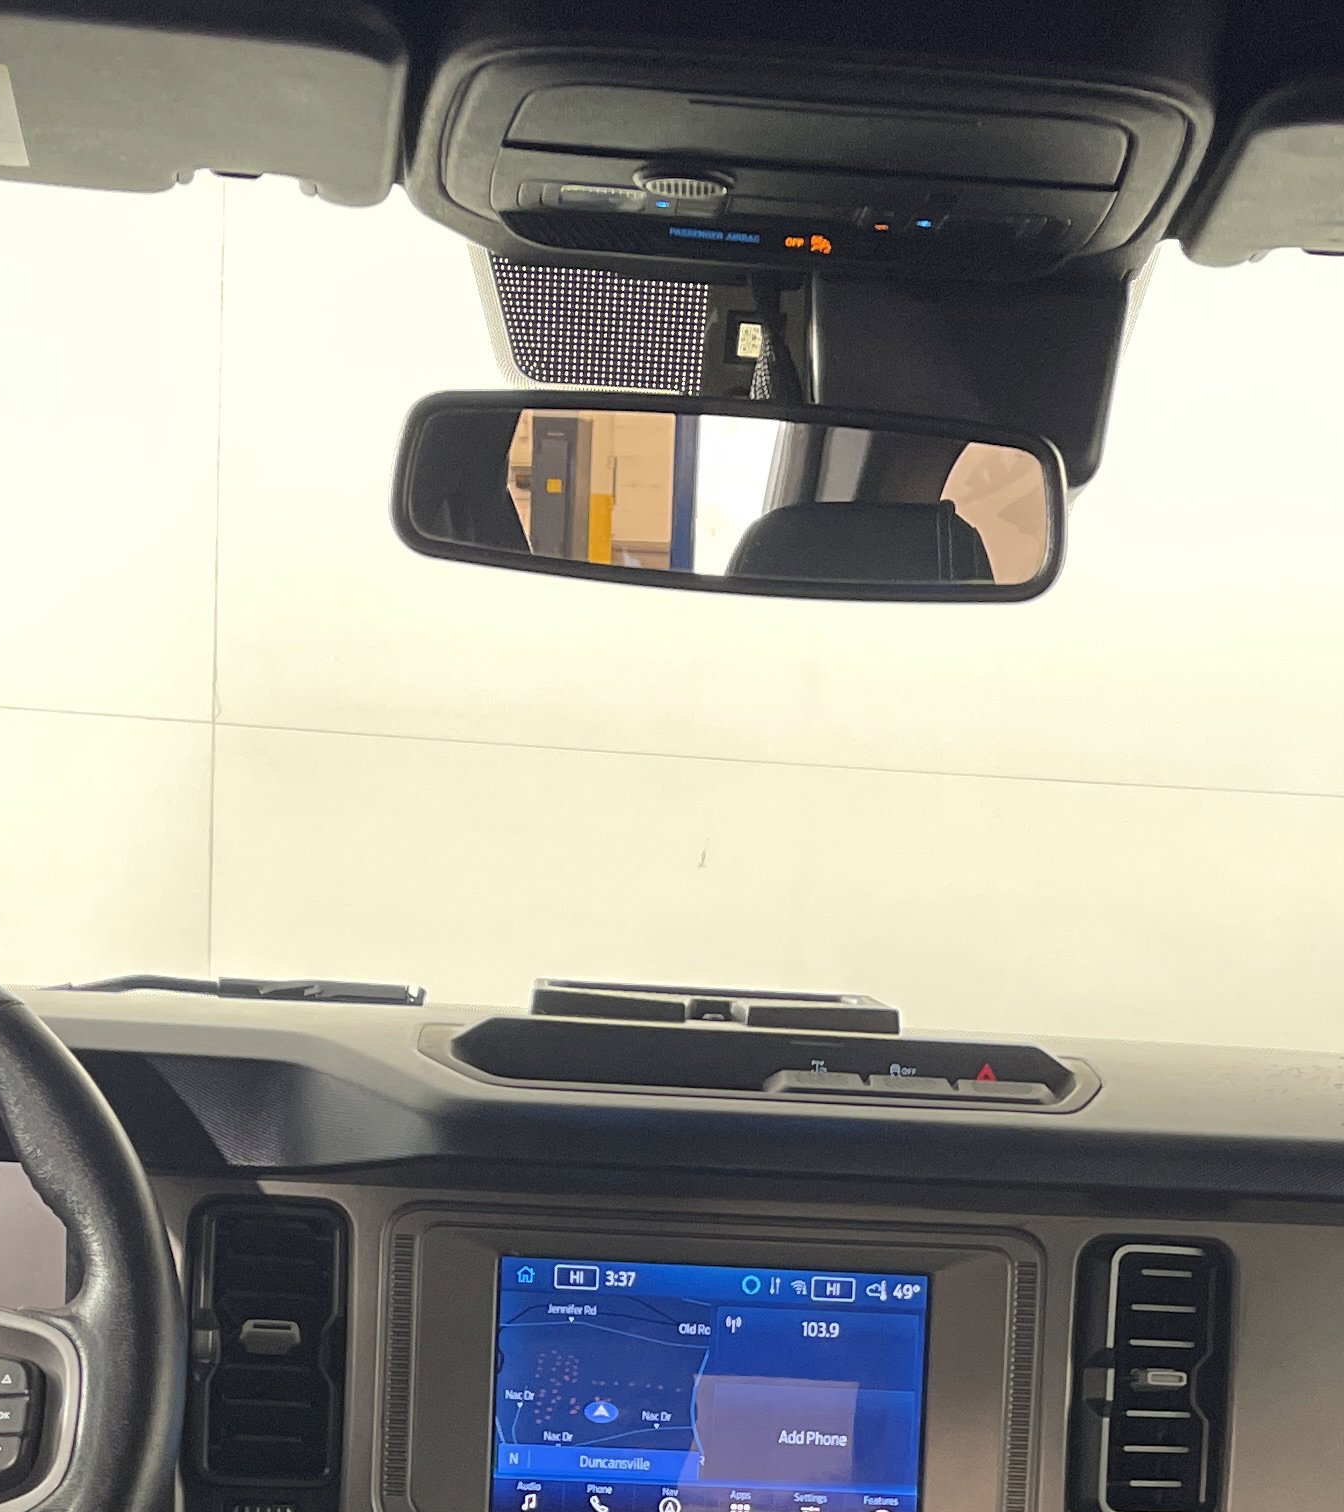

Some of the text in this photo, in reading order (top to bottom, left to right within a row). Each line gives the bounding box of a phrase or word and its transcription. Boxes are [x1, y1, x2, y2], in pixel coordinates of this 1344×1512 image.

[669, 226, 723, 240] PASSENGER
[605, 1270, 636, 1287] 3:37
[547, 1303, 597, 1316] Jennifer Rd
[802, 1321, 840, 1338] 103.9
[778, 1430, 848, 1447] Add Phone
[579, 1455, 651, 1471] Duncansville
[517, 1481, 542, 1492] Audio
[586, 1484, 613, 1495] Phone
[662, 1487, 679, 1497] Nav
[729, 1490, 752, 1501] Apps
[793, 1492, 828, 1505] Settings
[863, 1495, 899, 1507] Features
